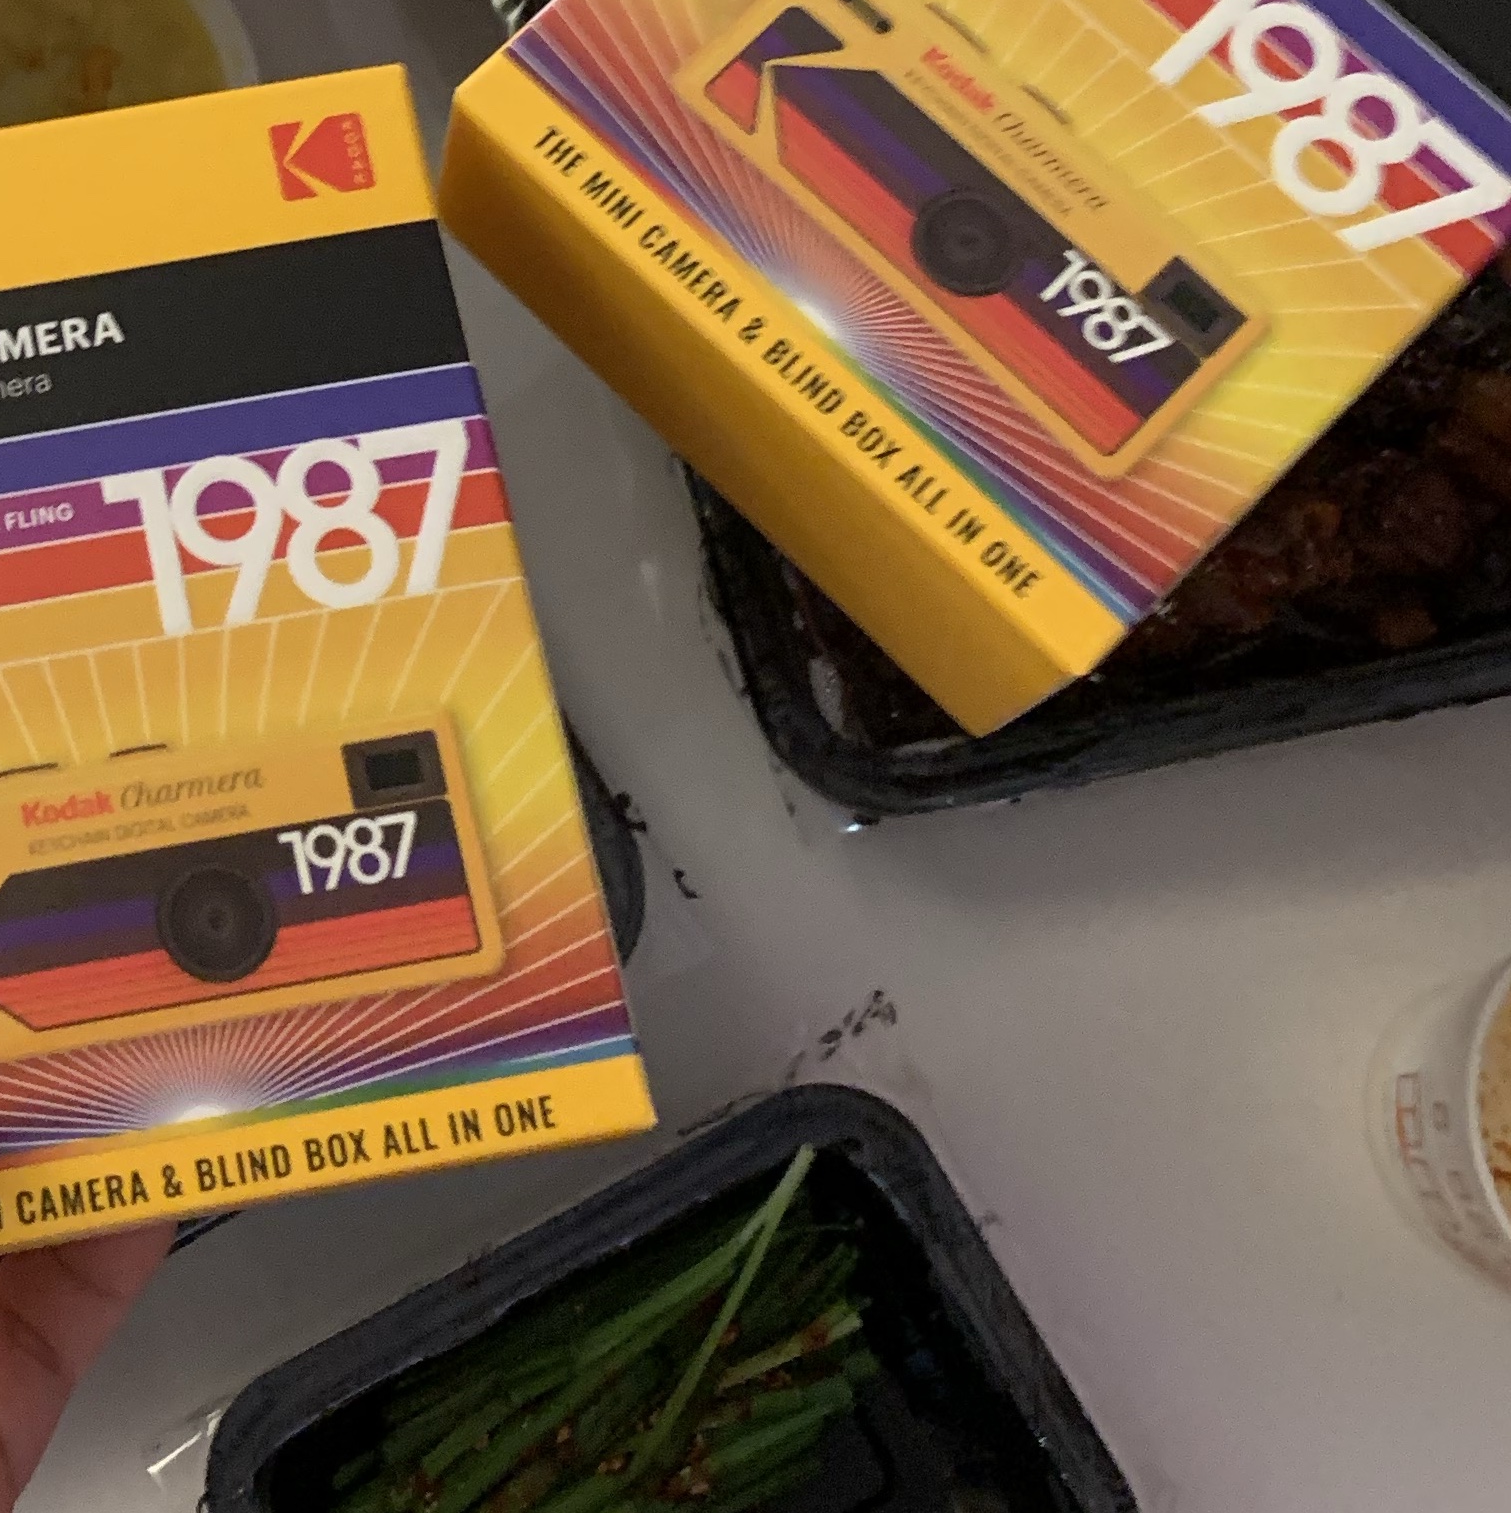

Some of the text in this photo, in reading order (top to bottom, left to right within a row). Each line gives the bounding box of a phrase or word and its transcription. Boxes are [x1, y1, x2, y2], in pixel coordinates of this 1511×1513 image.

[534, 125, 1042, 598] THE MINI CAMERA & BLIND BOX ALL IN ONE
[1040, 249, 1177, 364] 1987
[3, 502, 76, 533] FLING
[101, 420, 470, 636] 1987
[20, 765, 265, 828] Kodak Charmera
[277, 810, 418, 895] 1987
[16, 1169, 150, 1226] CAMERA
[161, 1163, 184, 1199] &
[194, 1143, 292, 1192] BLIND
[303, 1128, 371, 1173] BOX
[383, 1117, 440, 1159] ALL
[447, 1108, 483, 1145] IN
[493, 1094, 557, 1137] ONE
